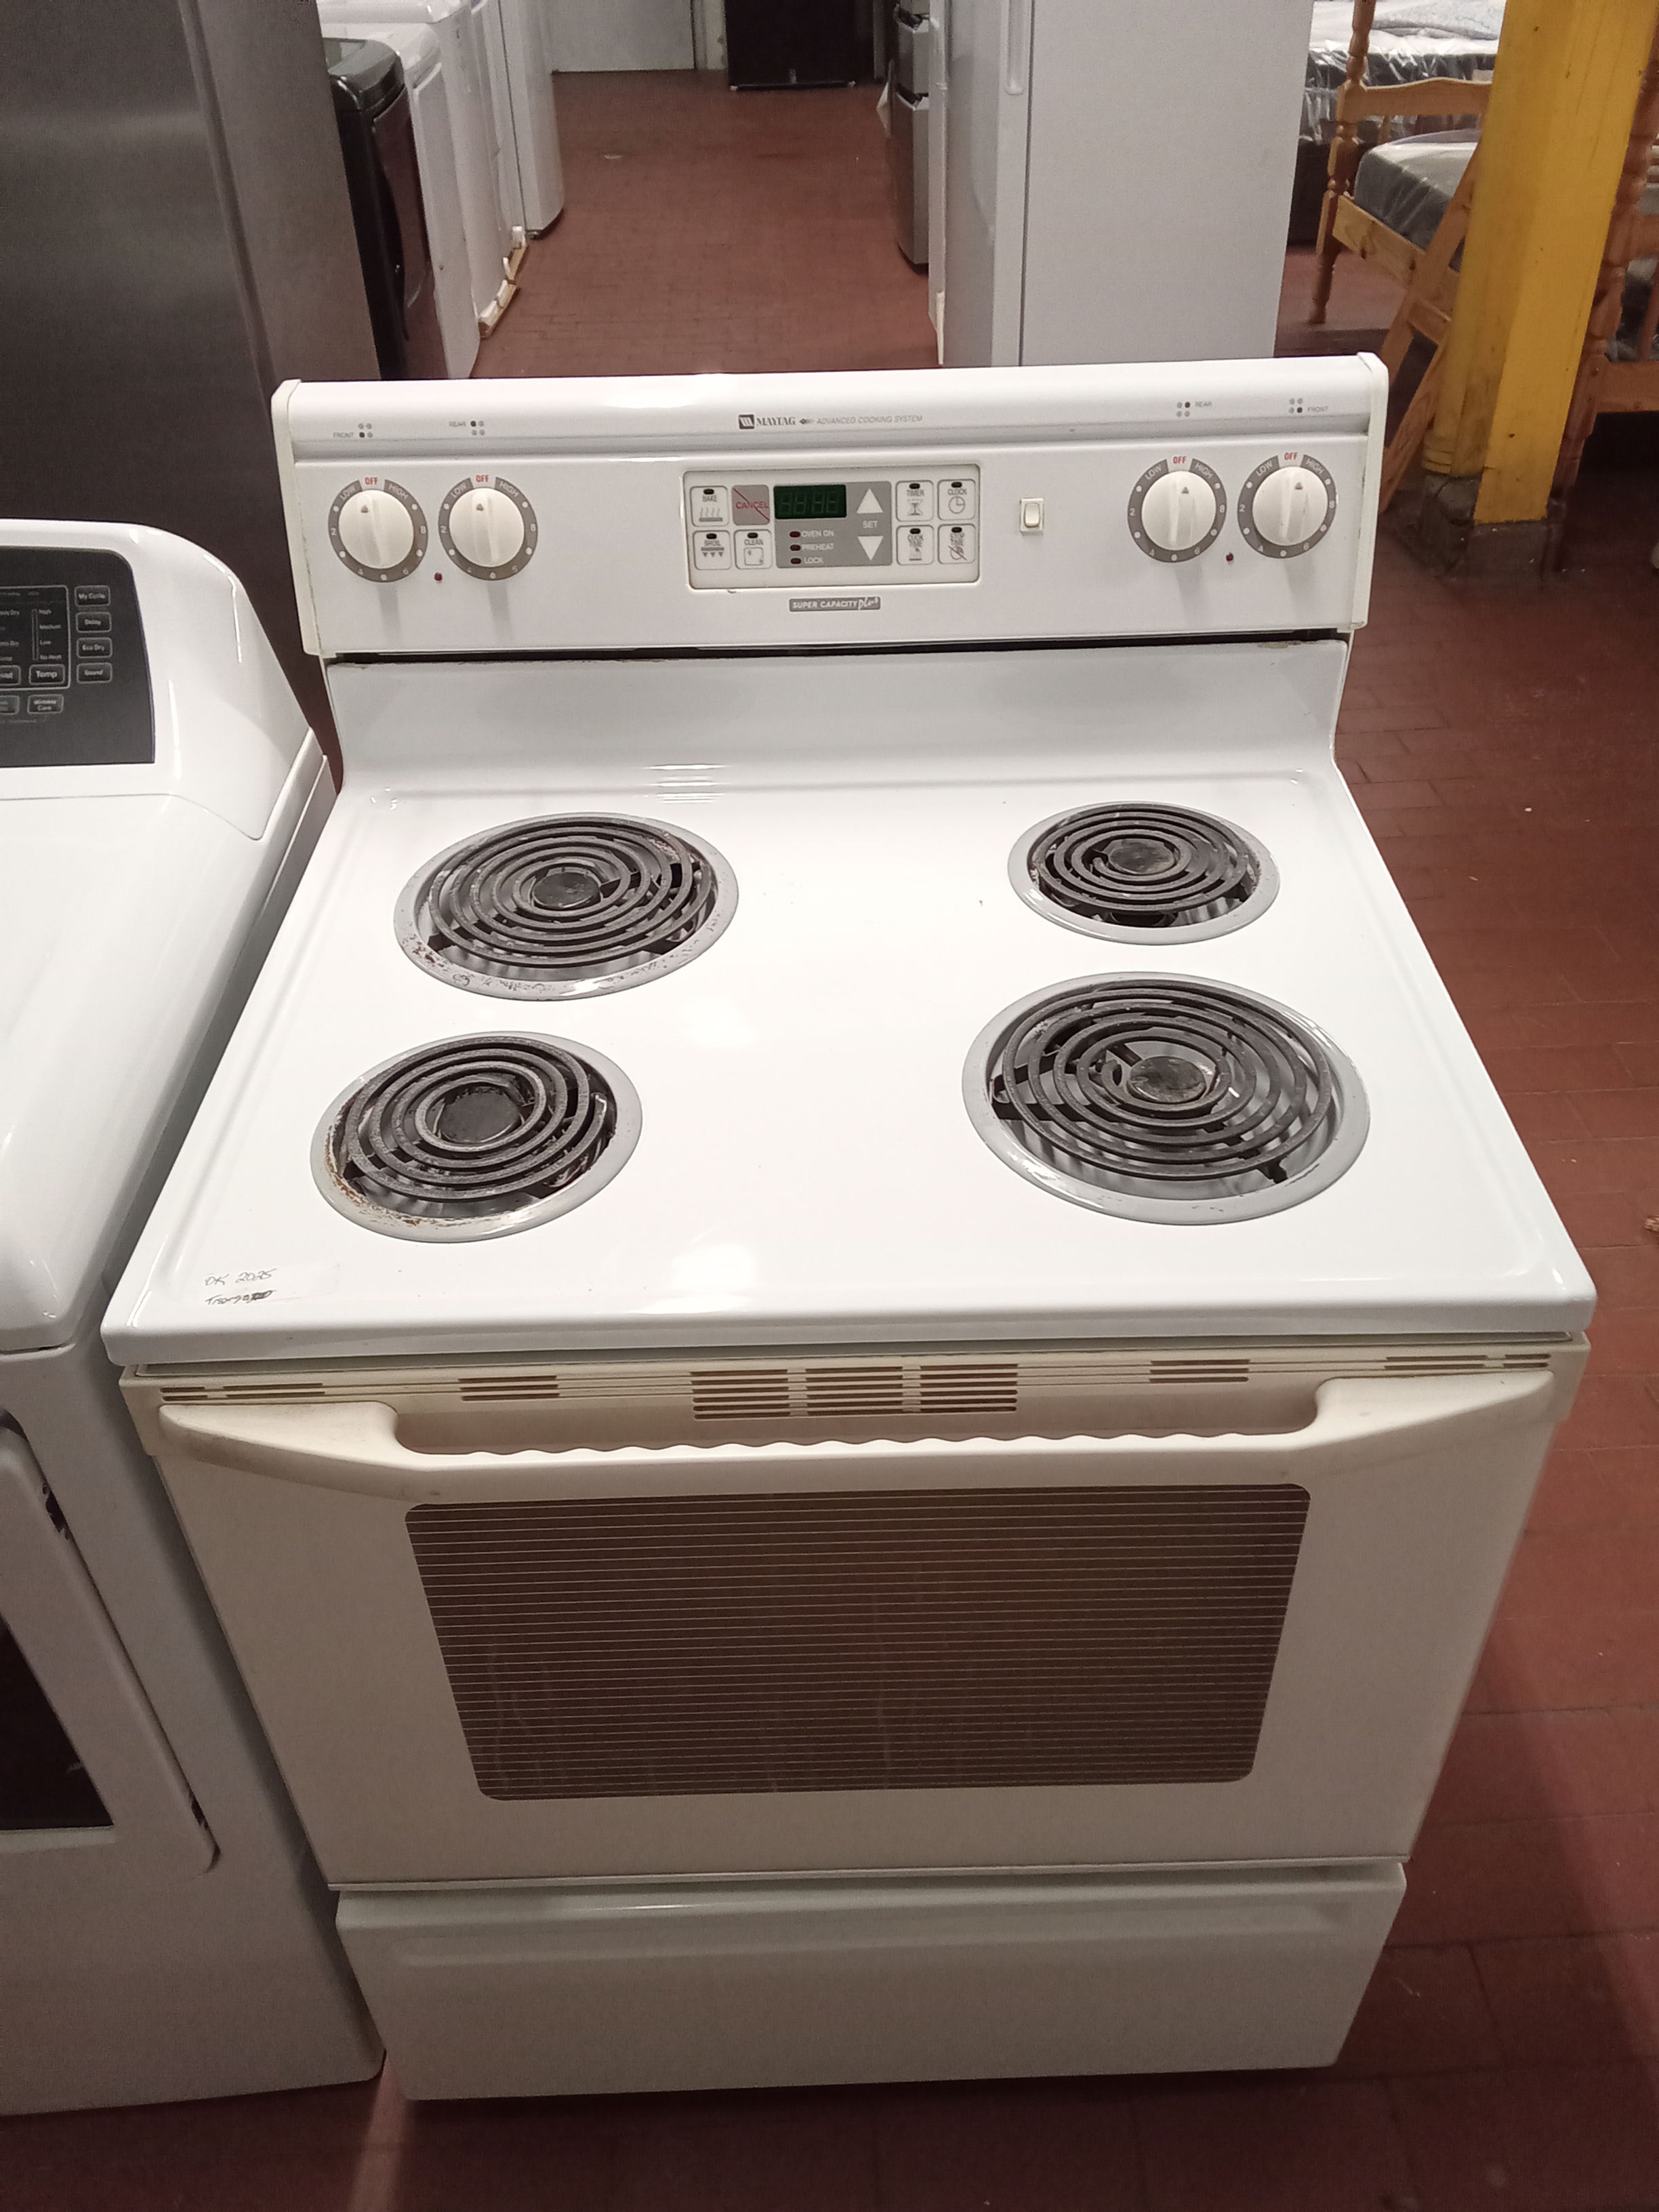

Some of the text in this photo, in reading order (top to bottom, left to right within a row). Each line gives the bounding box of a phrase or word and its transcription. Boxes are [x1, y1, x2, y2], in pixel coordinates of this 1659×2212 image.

[756, 417, 796, 426] MAYTAG
[817, 417, 855, 425] ADVANCED
[858, 415, 892, 424] COOKING
[1173, 455, 1187, 464] OFF
[1284, 452, 1298, 460] OFF
[1195, 462, 1214, 479] HIGH
[1256, 461, 1273, 476] LOW
[1305, 458, 1324, 475] HIGH
[1145, 464, 1162, 480] LOW
[365, 476, 378, 485] OFF
[476, 474, 489, 483] OFF
[340, 484, 355, 500] LOW
[388, 483, 408, 499] HIGH
[450, 482, 466, 498] LOW
[499, 480, 519, 497] HIGH
[735, 501, 769, 510] CANCEL
[1219, 504, 1226, 514] 8
[1239, 504, 1246, 512] 2
[1129, 508, 1136, 516] 2
[441, 525, 447, 533] 2
[530, 523, 537, 532] 8
[862, 520, 879, 529] SET
[330, 527, 337, 536] 2
[801, 530, 822, 538] OVEN
[802, 543, 834, 552] PREHEAT
[820, 600, 857, 608] CAPACITY
[35, 670, 58, 679] Temp
